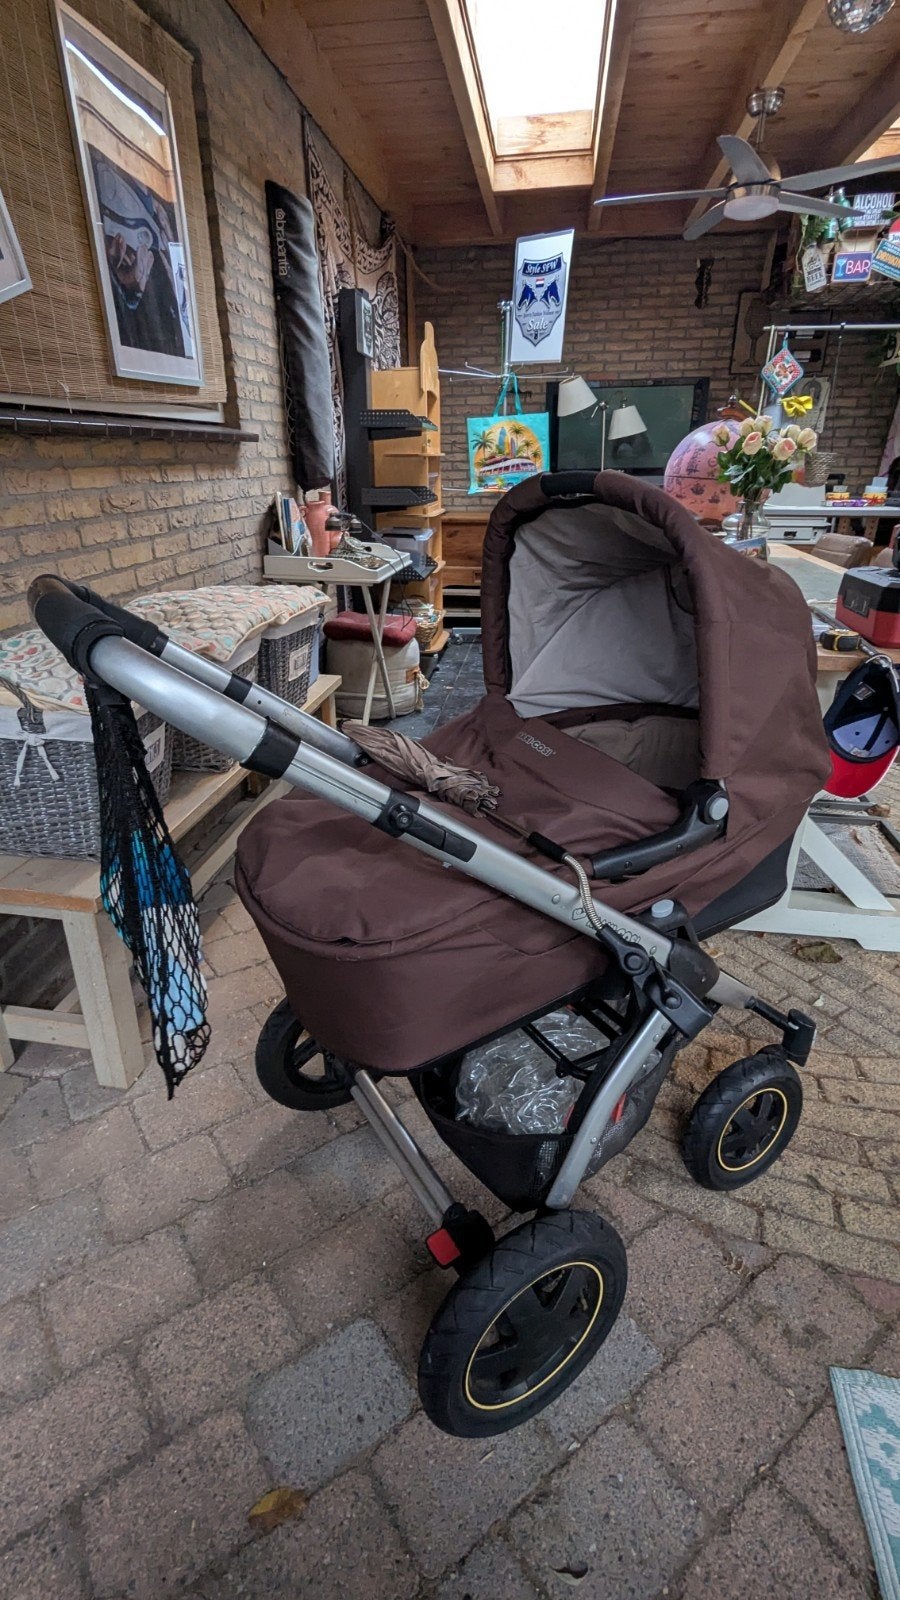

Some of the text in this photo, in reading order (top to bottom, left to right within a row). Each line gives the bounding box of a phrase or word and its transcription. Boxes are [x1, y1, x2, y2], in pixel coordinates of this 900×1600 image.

[276, 220, 289, 275] brabantia
[845, 259, 871, 275] BAR
[527, 317, 548, 331] Sale
